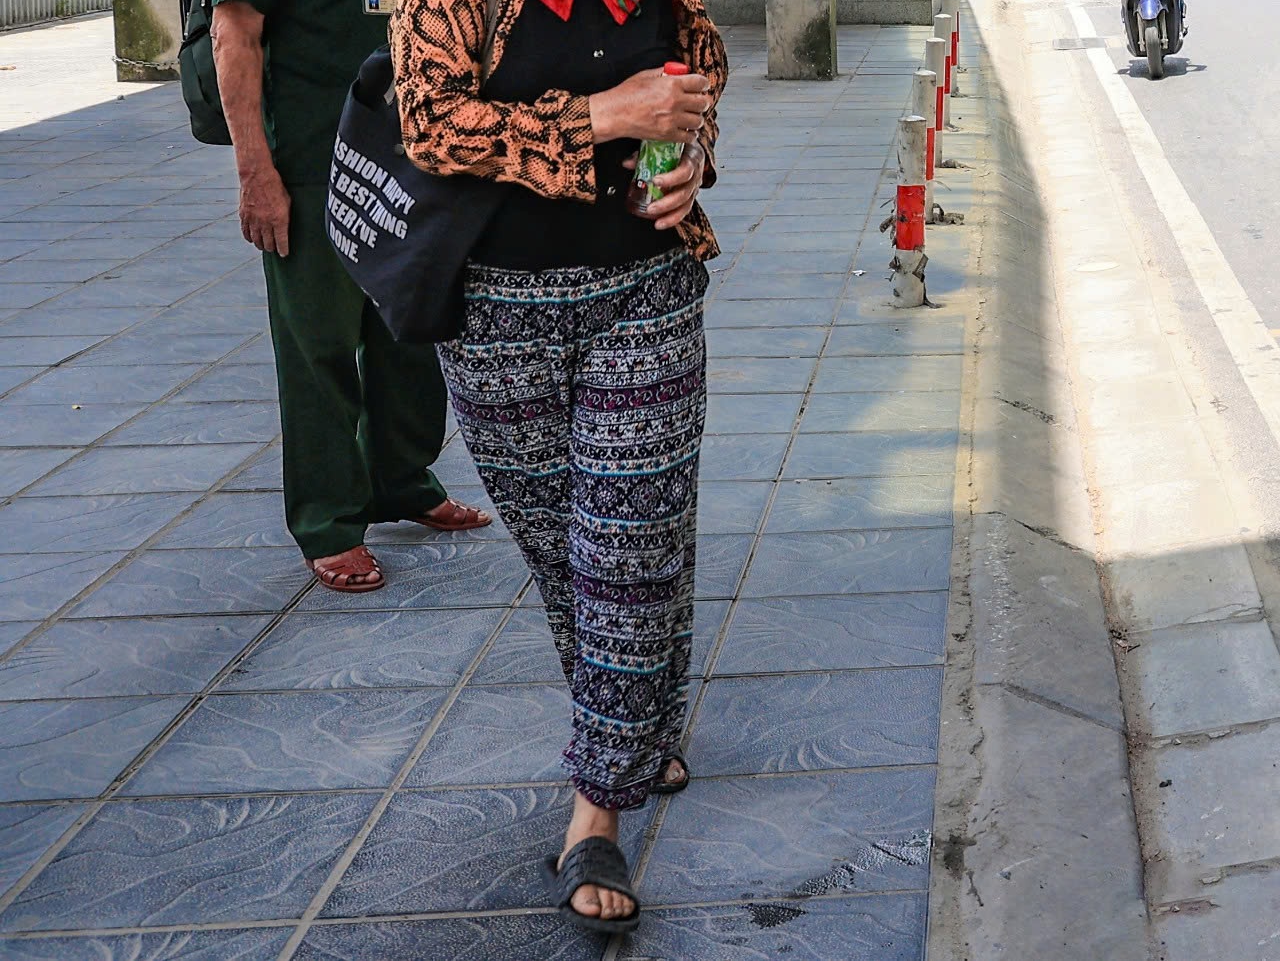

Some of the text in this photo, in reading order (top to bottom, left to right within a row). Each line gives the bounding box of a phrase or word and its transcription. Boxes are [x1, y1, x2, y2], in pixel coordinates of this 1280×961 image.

[335, 172, 377, 211] BEST
[369, 199, 408, 240] THING
[382, 176, 416, 215] HAPPY
[329, 220, 359, 264] DONE.
